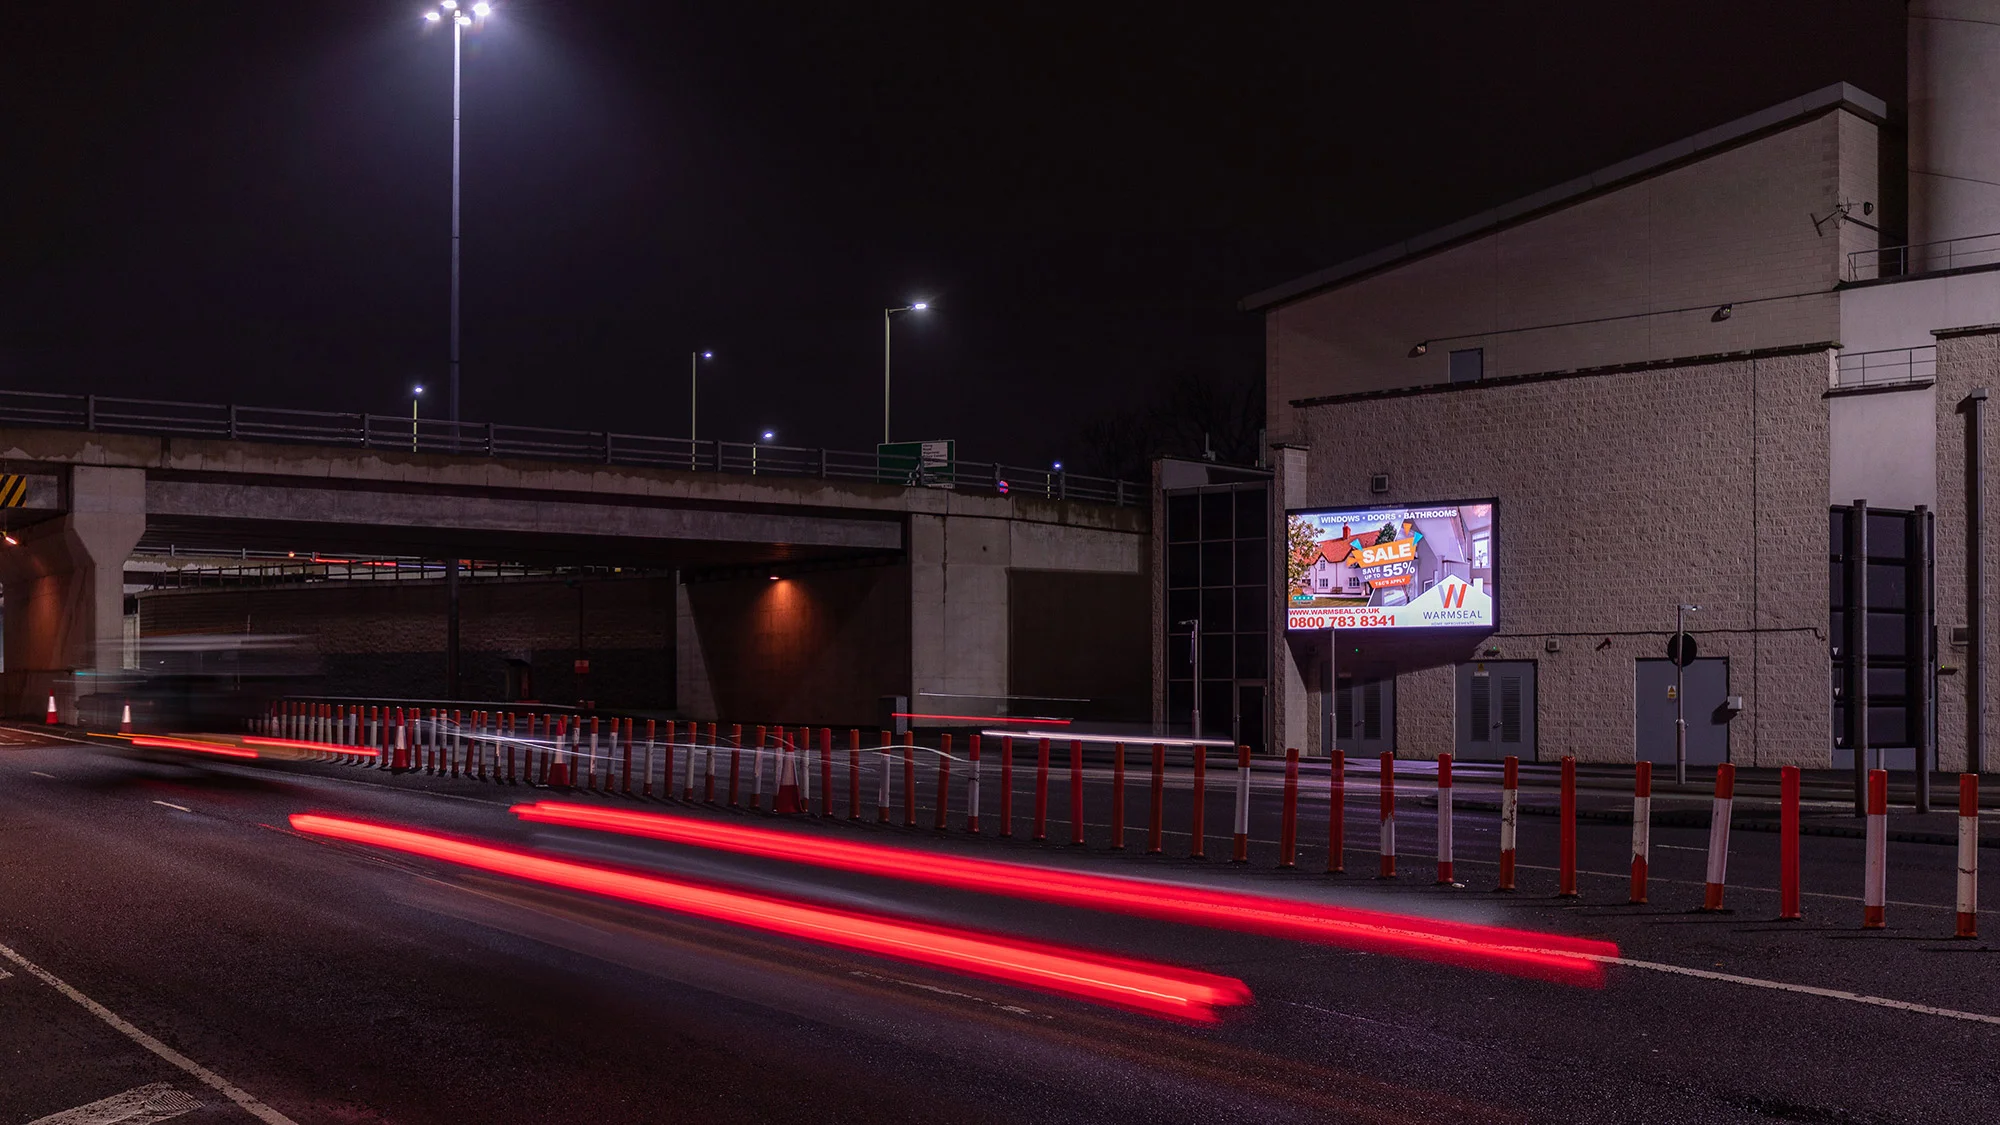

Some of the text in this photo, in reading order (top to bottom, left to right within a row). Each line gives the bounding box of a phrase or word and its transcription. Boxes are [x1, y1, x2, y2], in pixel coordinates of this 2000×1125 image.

[1321, 509, 1457, 523] WINDOWS DOORS BATHROOMS
[1362, 543, 1412, 564] SALE
[1362, 566, 1380, 575] SAVE
[1383, 561, 1416, 577] 55%
[1289, 608, 1380, 616] WWW.WARMSEAL.CO.UK
[1423, 610, 1482, 620] WARMSEAL
[1289, 614, 1395, 628] 0800 783 8341
